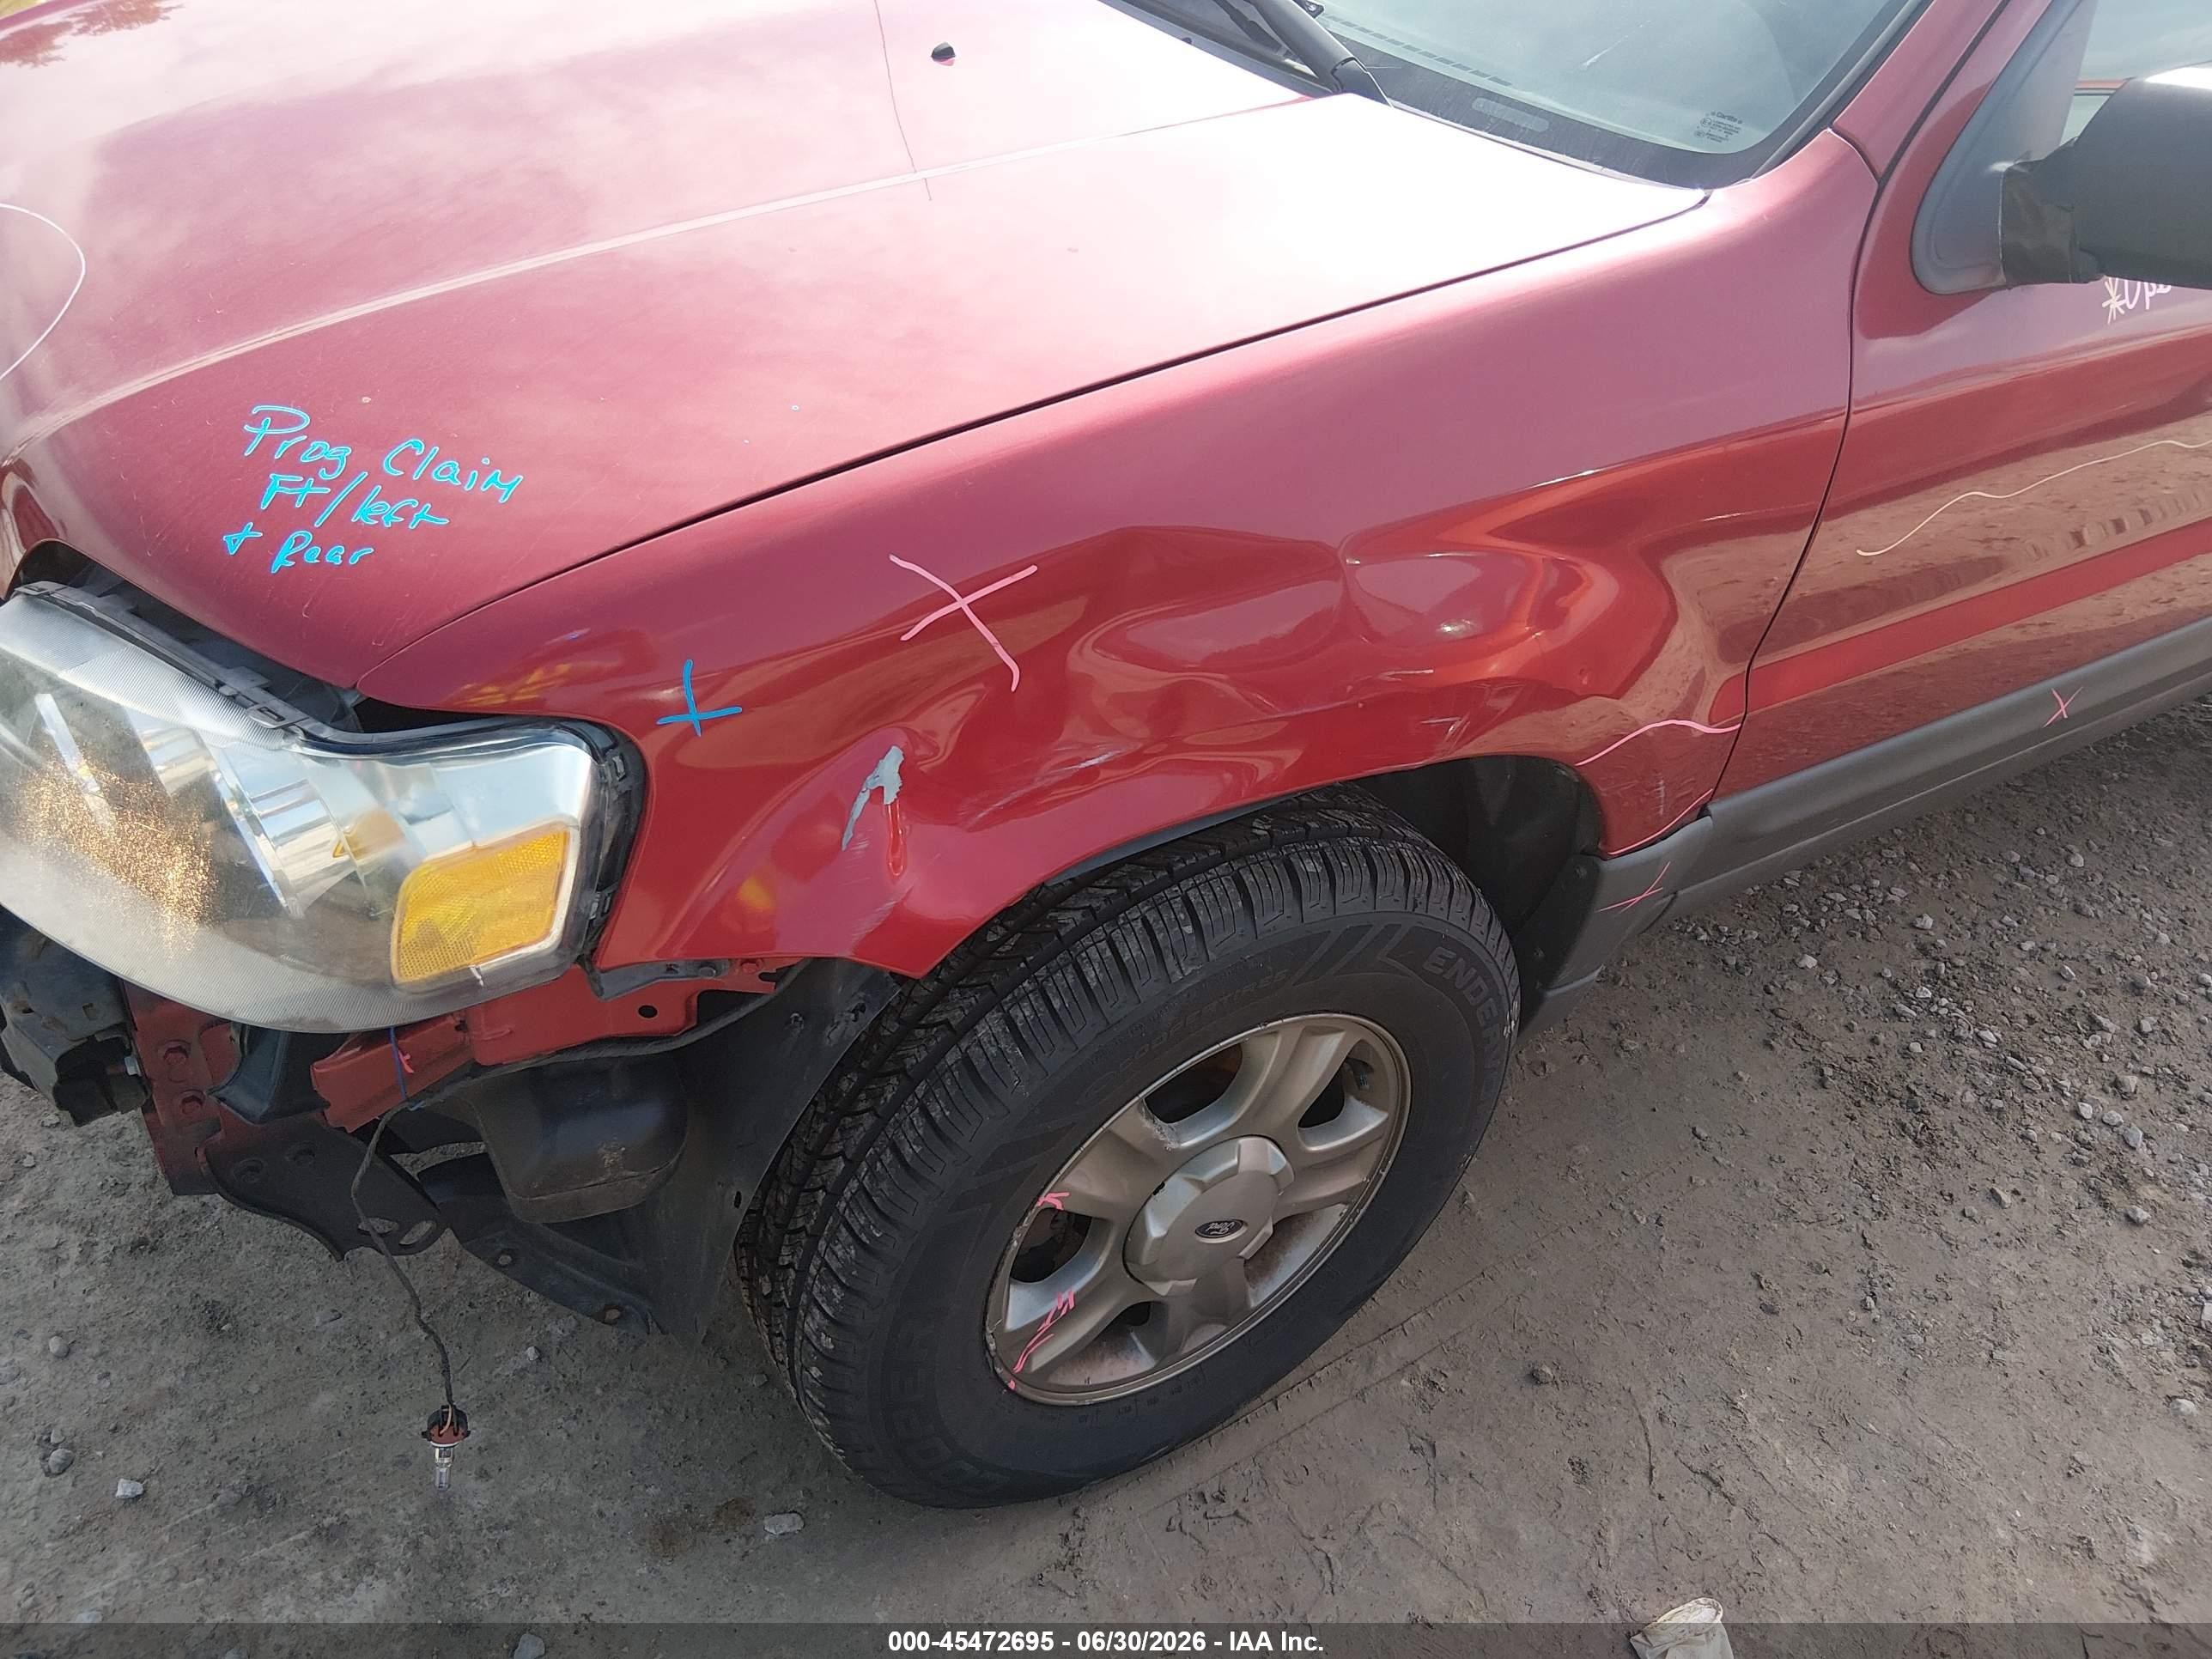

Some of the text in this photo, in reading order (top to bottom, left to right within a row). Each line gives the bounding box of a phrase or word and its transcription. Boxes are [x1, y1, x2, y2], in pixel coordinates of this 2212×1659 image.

[244, 404, 525, 504] Prog Claim
[270, 529, 375, 574] Rear
[1204, 1220, 1236, 1236] Ford
